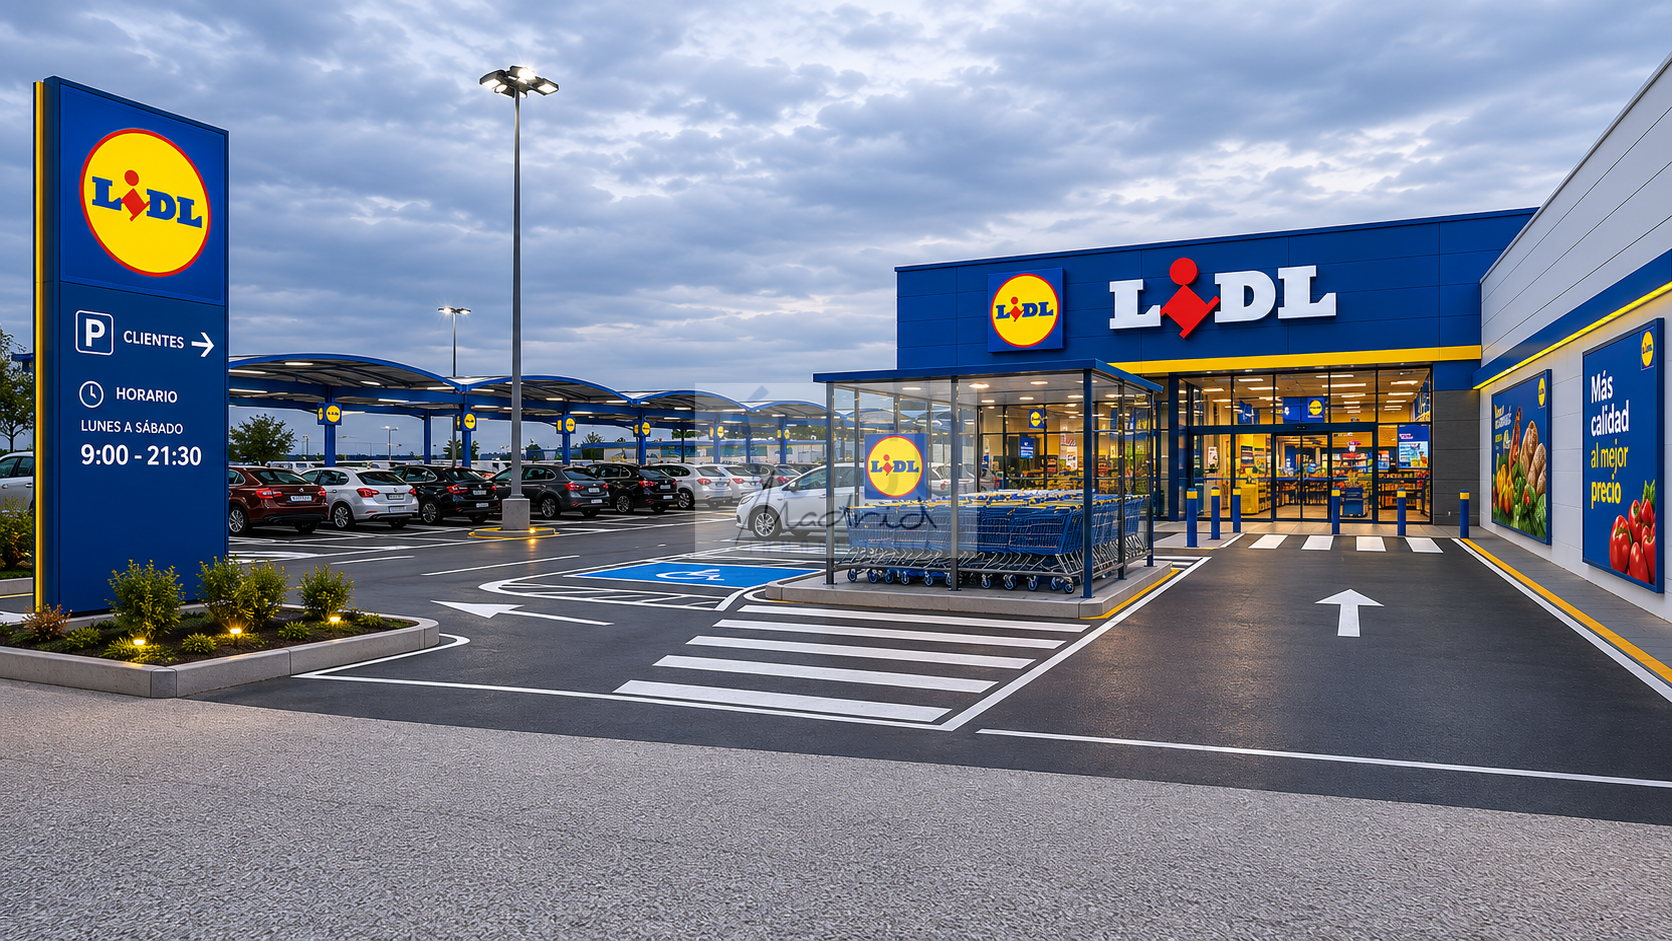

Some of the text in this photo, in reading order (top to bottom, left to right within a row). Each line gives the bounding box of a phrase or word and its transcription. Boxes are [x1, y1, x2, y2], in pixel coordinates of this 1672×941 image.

[85, 318, 185, 349] P CLIENTES
[116, 386, 178, 404] HORARIO
[1591, 369, 1614, 404] Más
[81, 419, 184, 435] LUNES A SÁBADO
[1590, 399, 1630, 437] calidad
[80, 443, 129, 466] 9:00
[147, 445, 202, 466] 21:30
[1590, 438, 1629, 474] al mejor
[1590, 473, 1622, 510] precio
